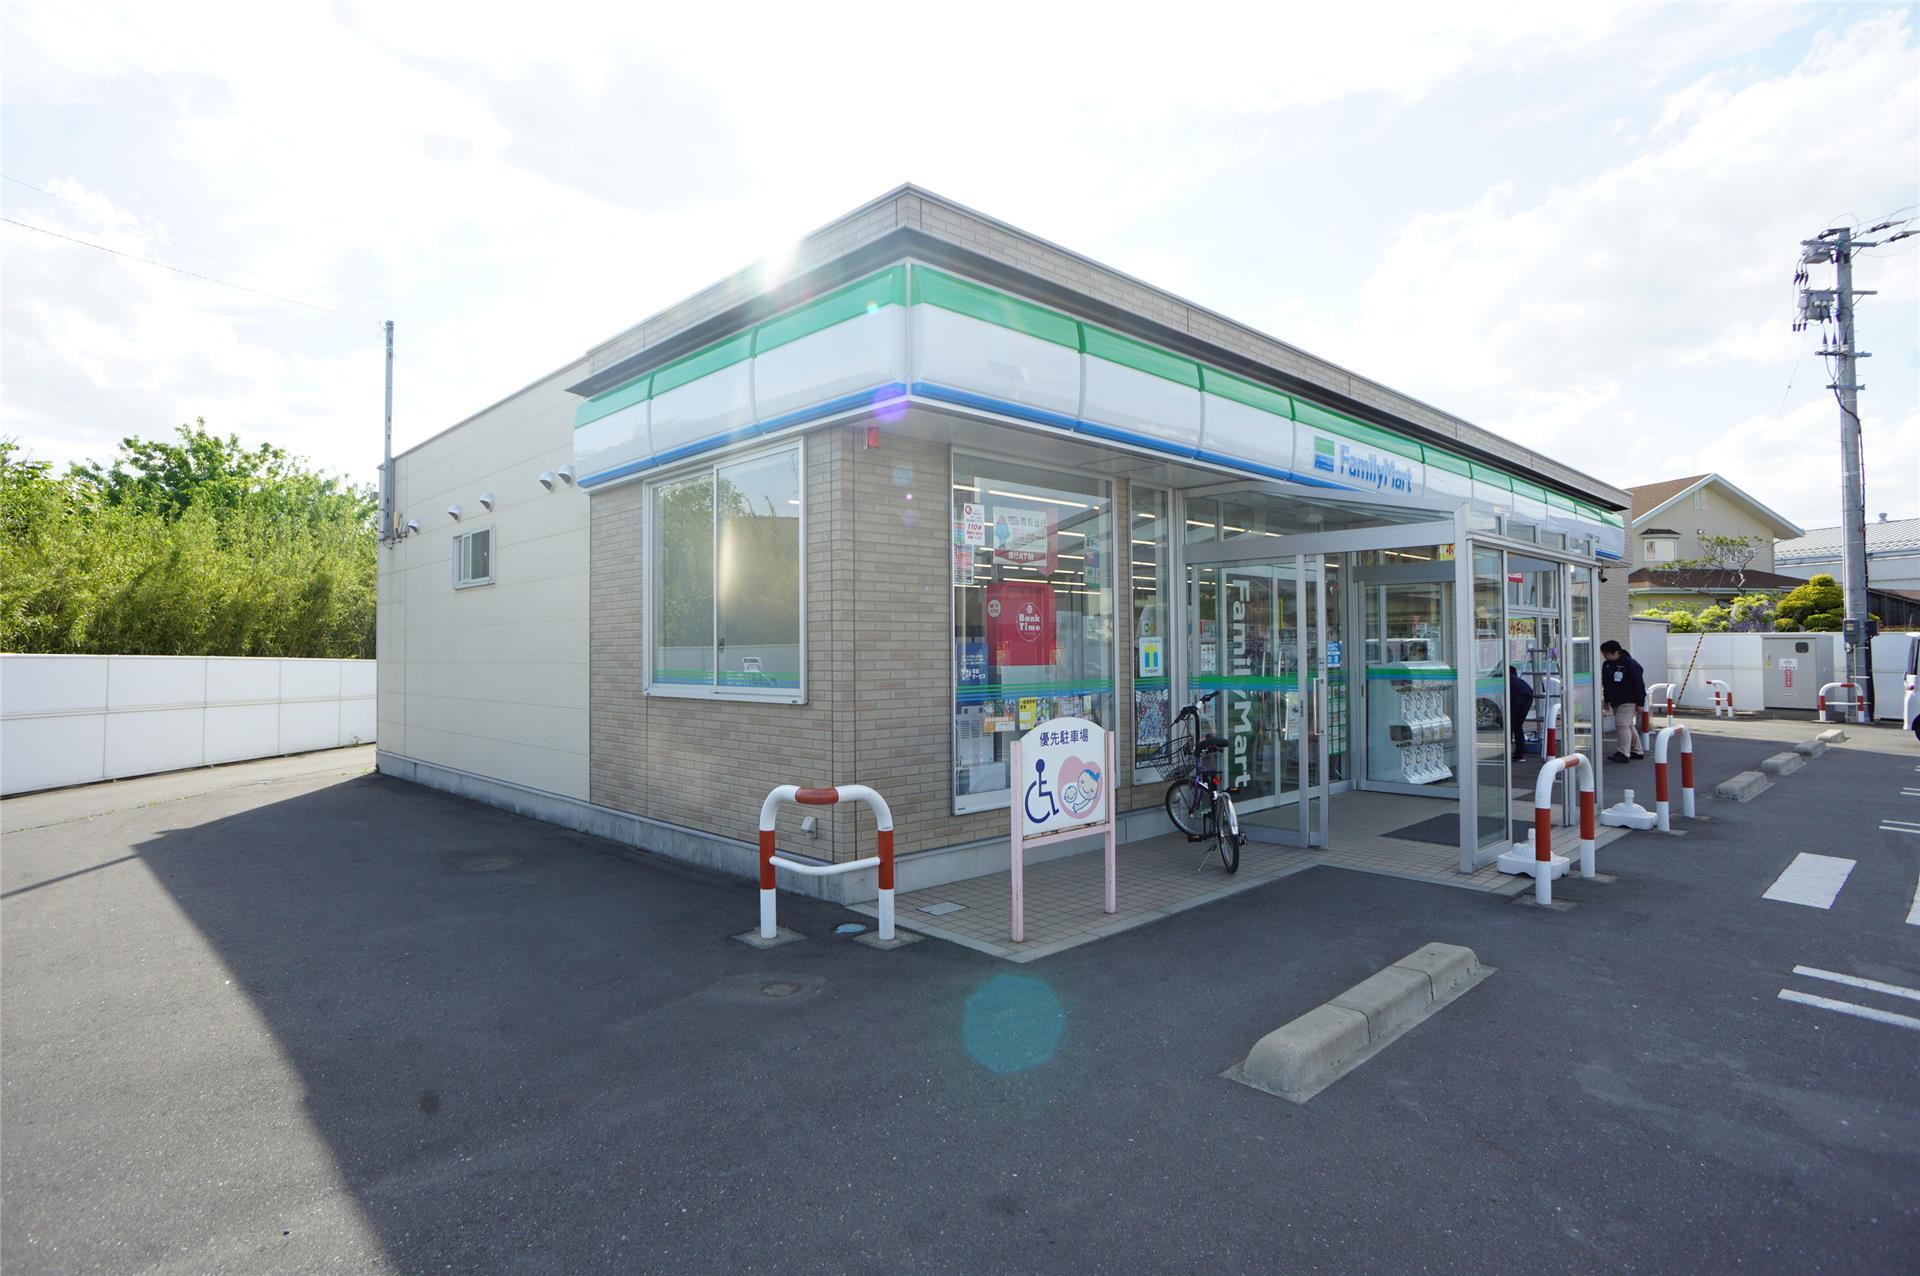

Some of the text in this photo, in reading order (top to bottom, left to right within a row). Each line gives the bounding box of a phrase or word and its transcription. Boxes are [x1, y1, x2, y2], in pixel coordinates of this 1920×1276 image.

[1340, 444, 1412, 493] FamilyMart
[1019, 613, 1040, 622] Bank
[1019, 623, 1040, 631] Time
[1040, 728, 1089, 747] 優先駐車場
